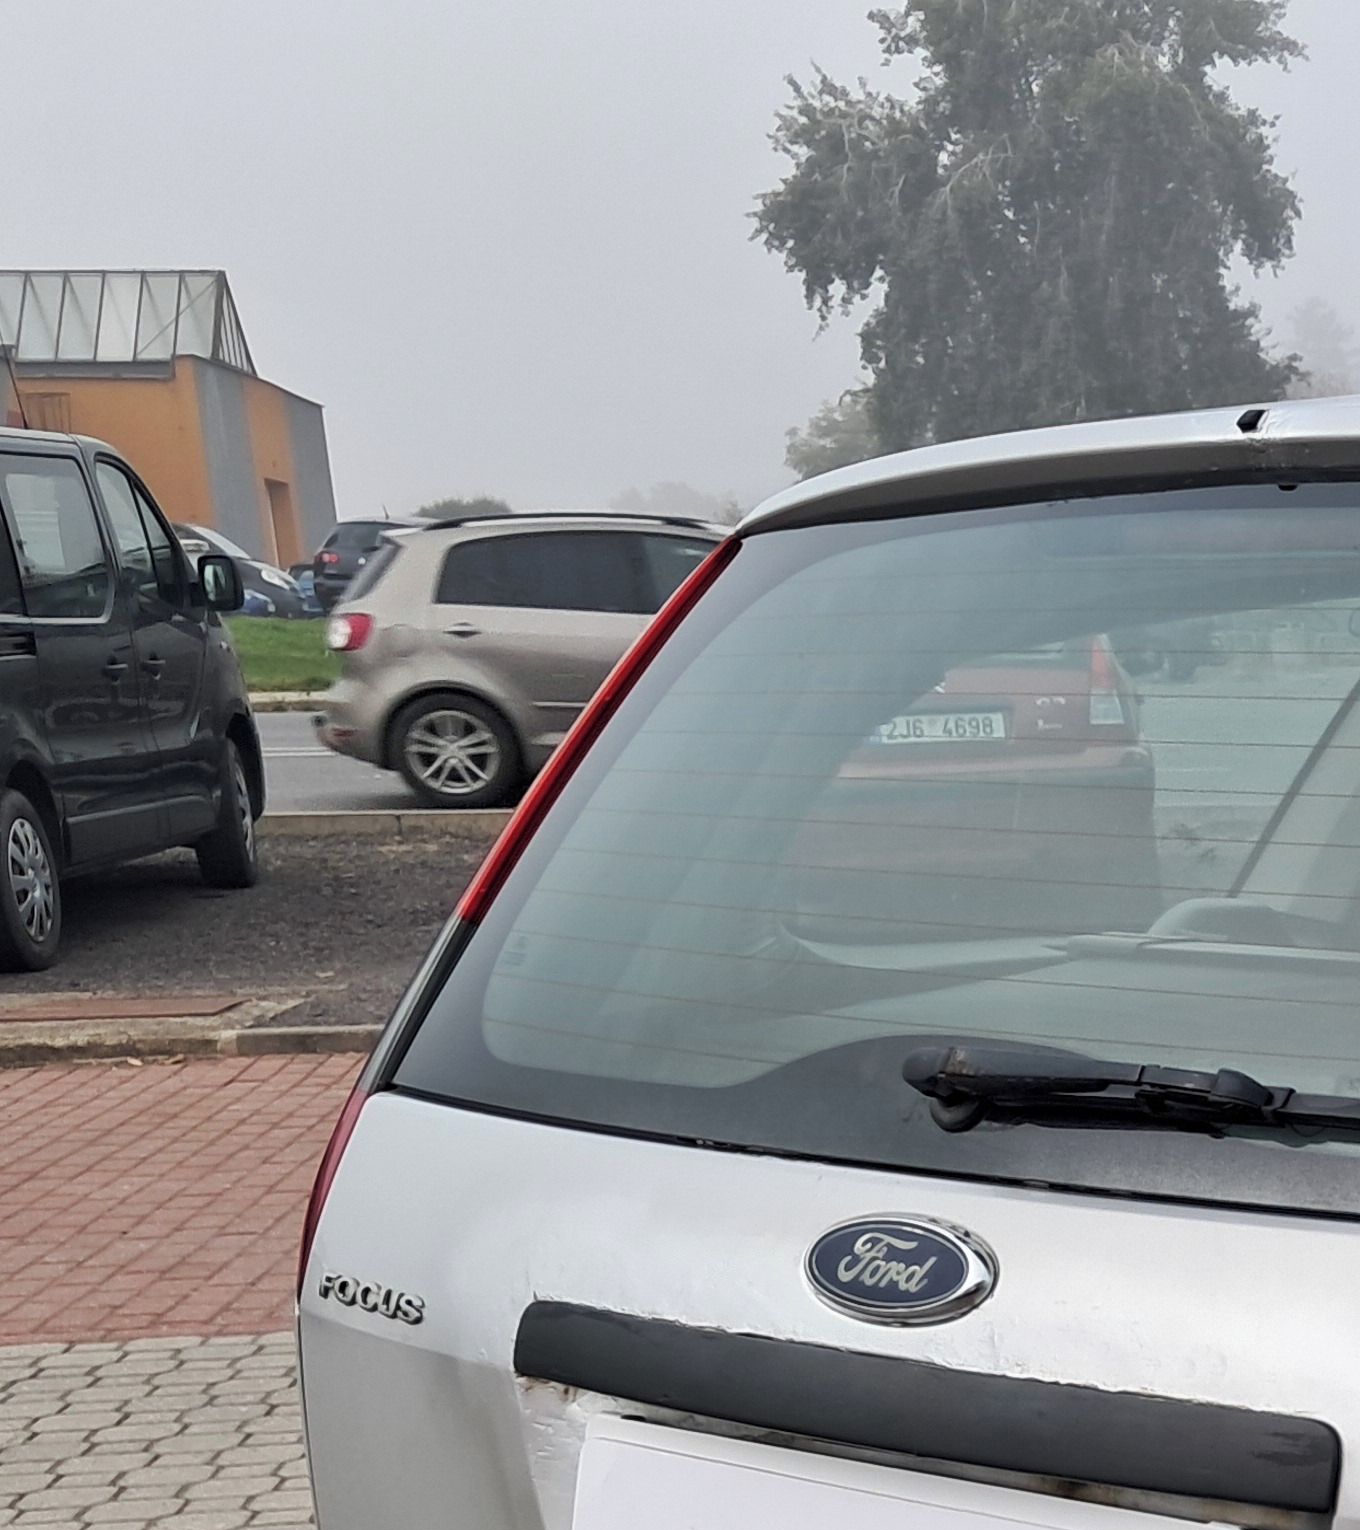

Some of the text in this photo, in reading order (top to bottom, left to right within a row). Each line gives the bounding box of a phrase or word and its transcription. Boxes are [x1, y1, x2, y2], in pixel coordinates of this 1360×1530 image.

[886, 716, 994, 740] 2J6 4698
[837, 1232, 937, 1293] Ford
[319, 1273, 426, 1326] FOCUS
